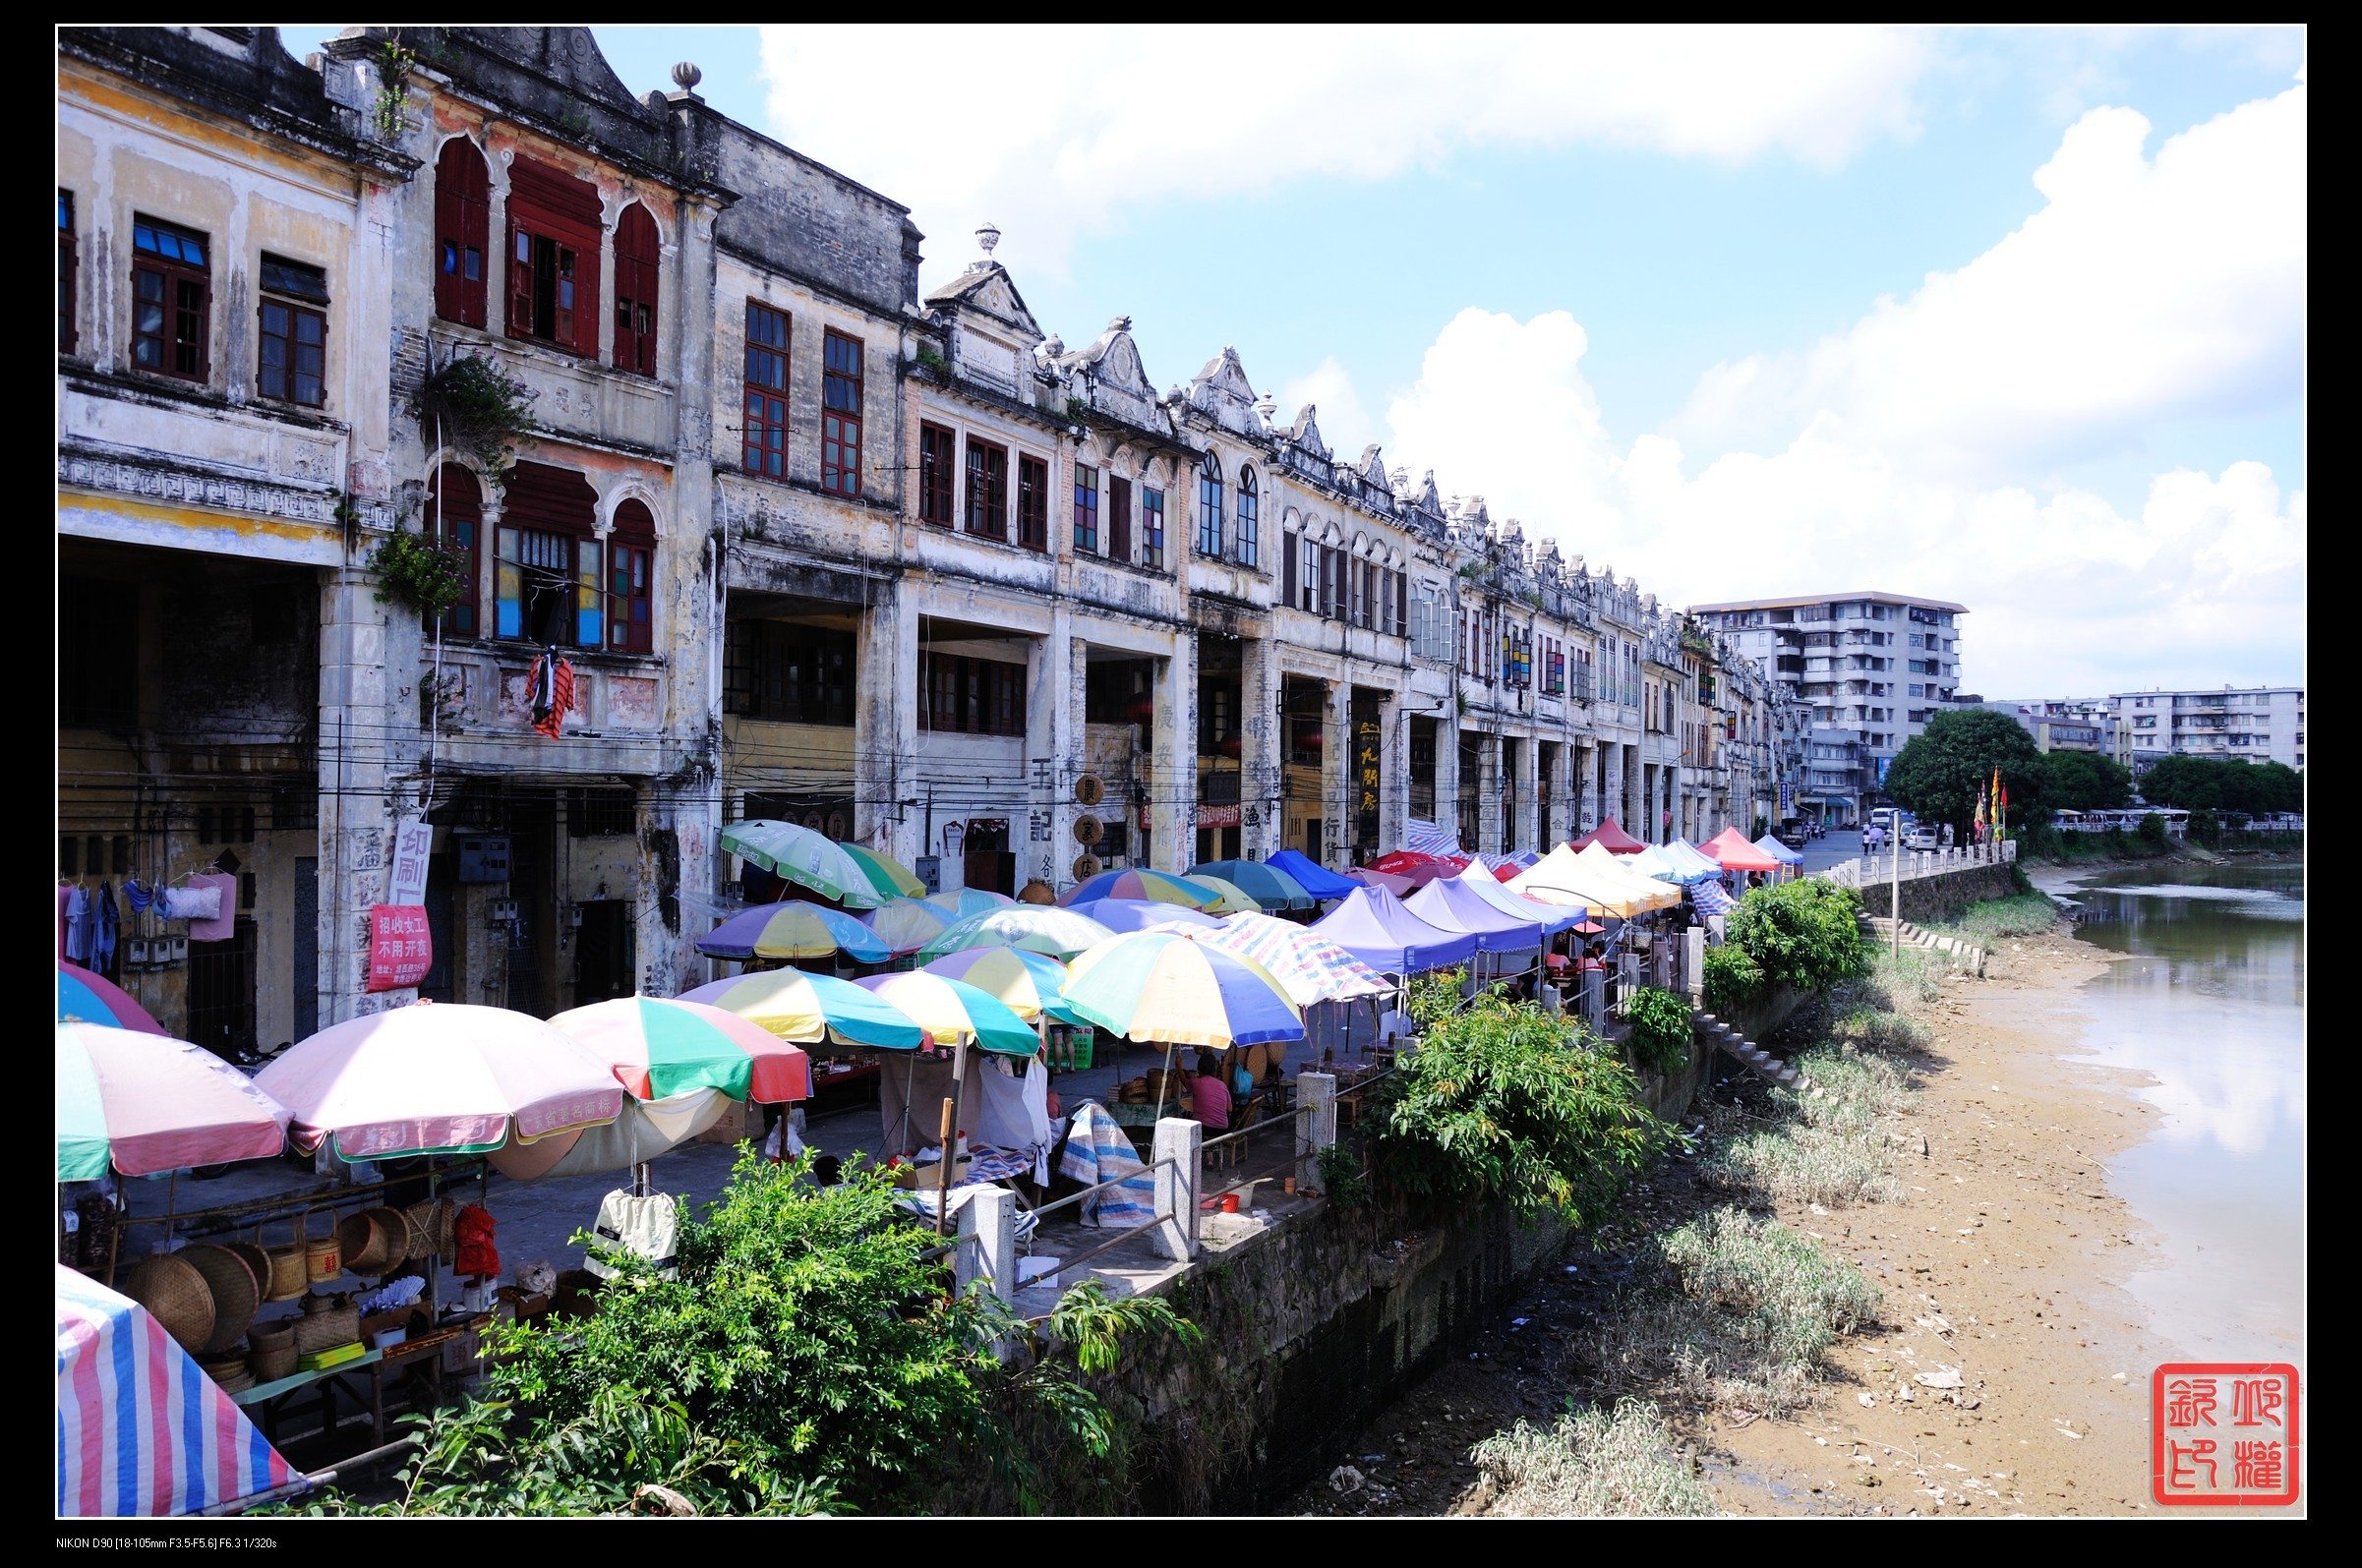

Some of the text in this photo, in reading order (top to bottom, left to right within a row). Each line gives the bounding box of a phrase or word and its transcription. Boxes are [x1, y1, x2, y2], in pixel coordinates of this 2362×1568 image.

[396, 828, 428, 904] 印刷厂
[379, 916, 425, 934] 招收女工
[379, 939, 427, 958] 不用开夜
